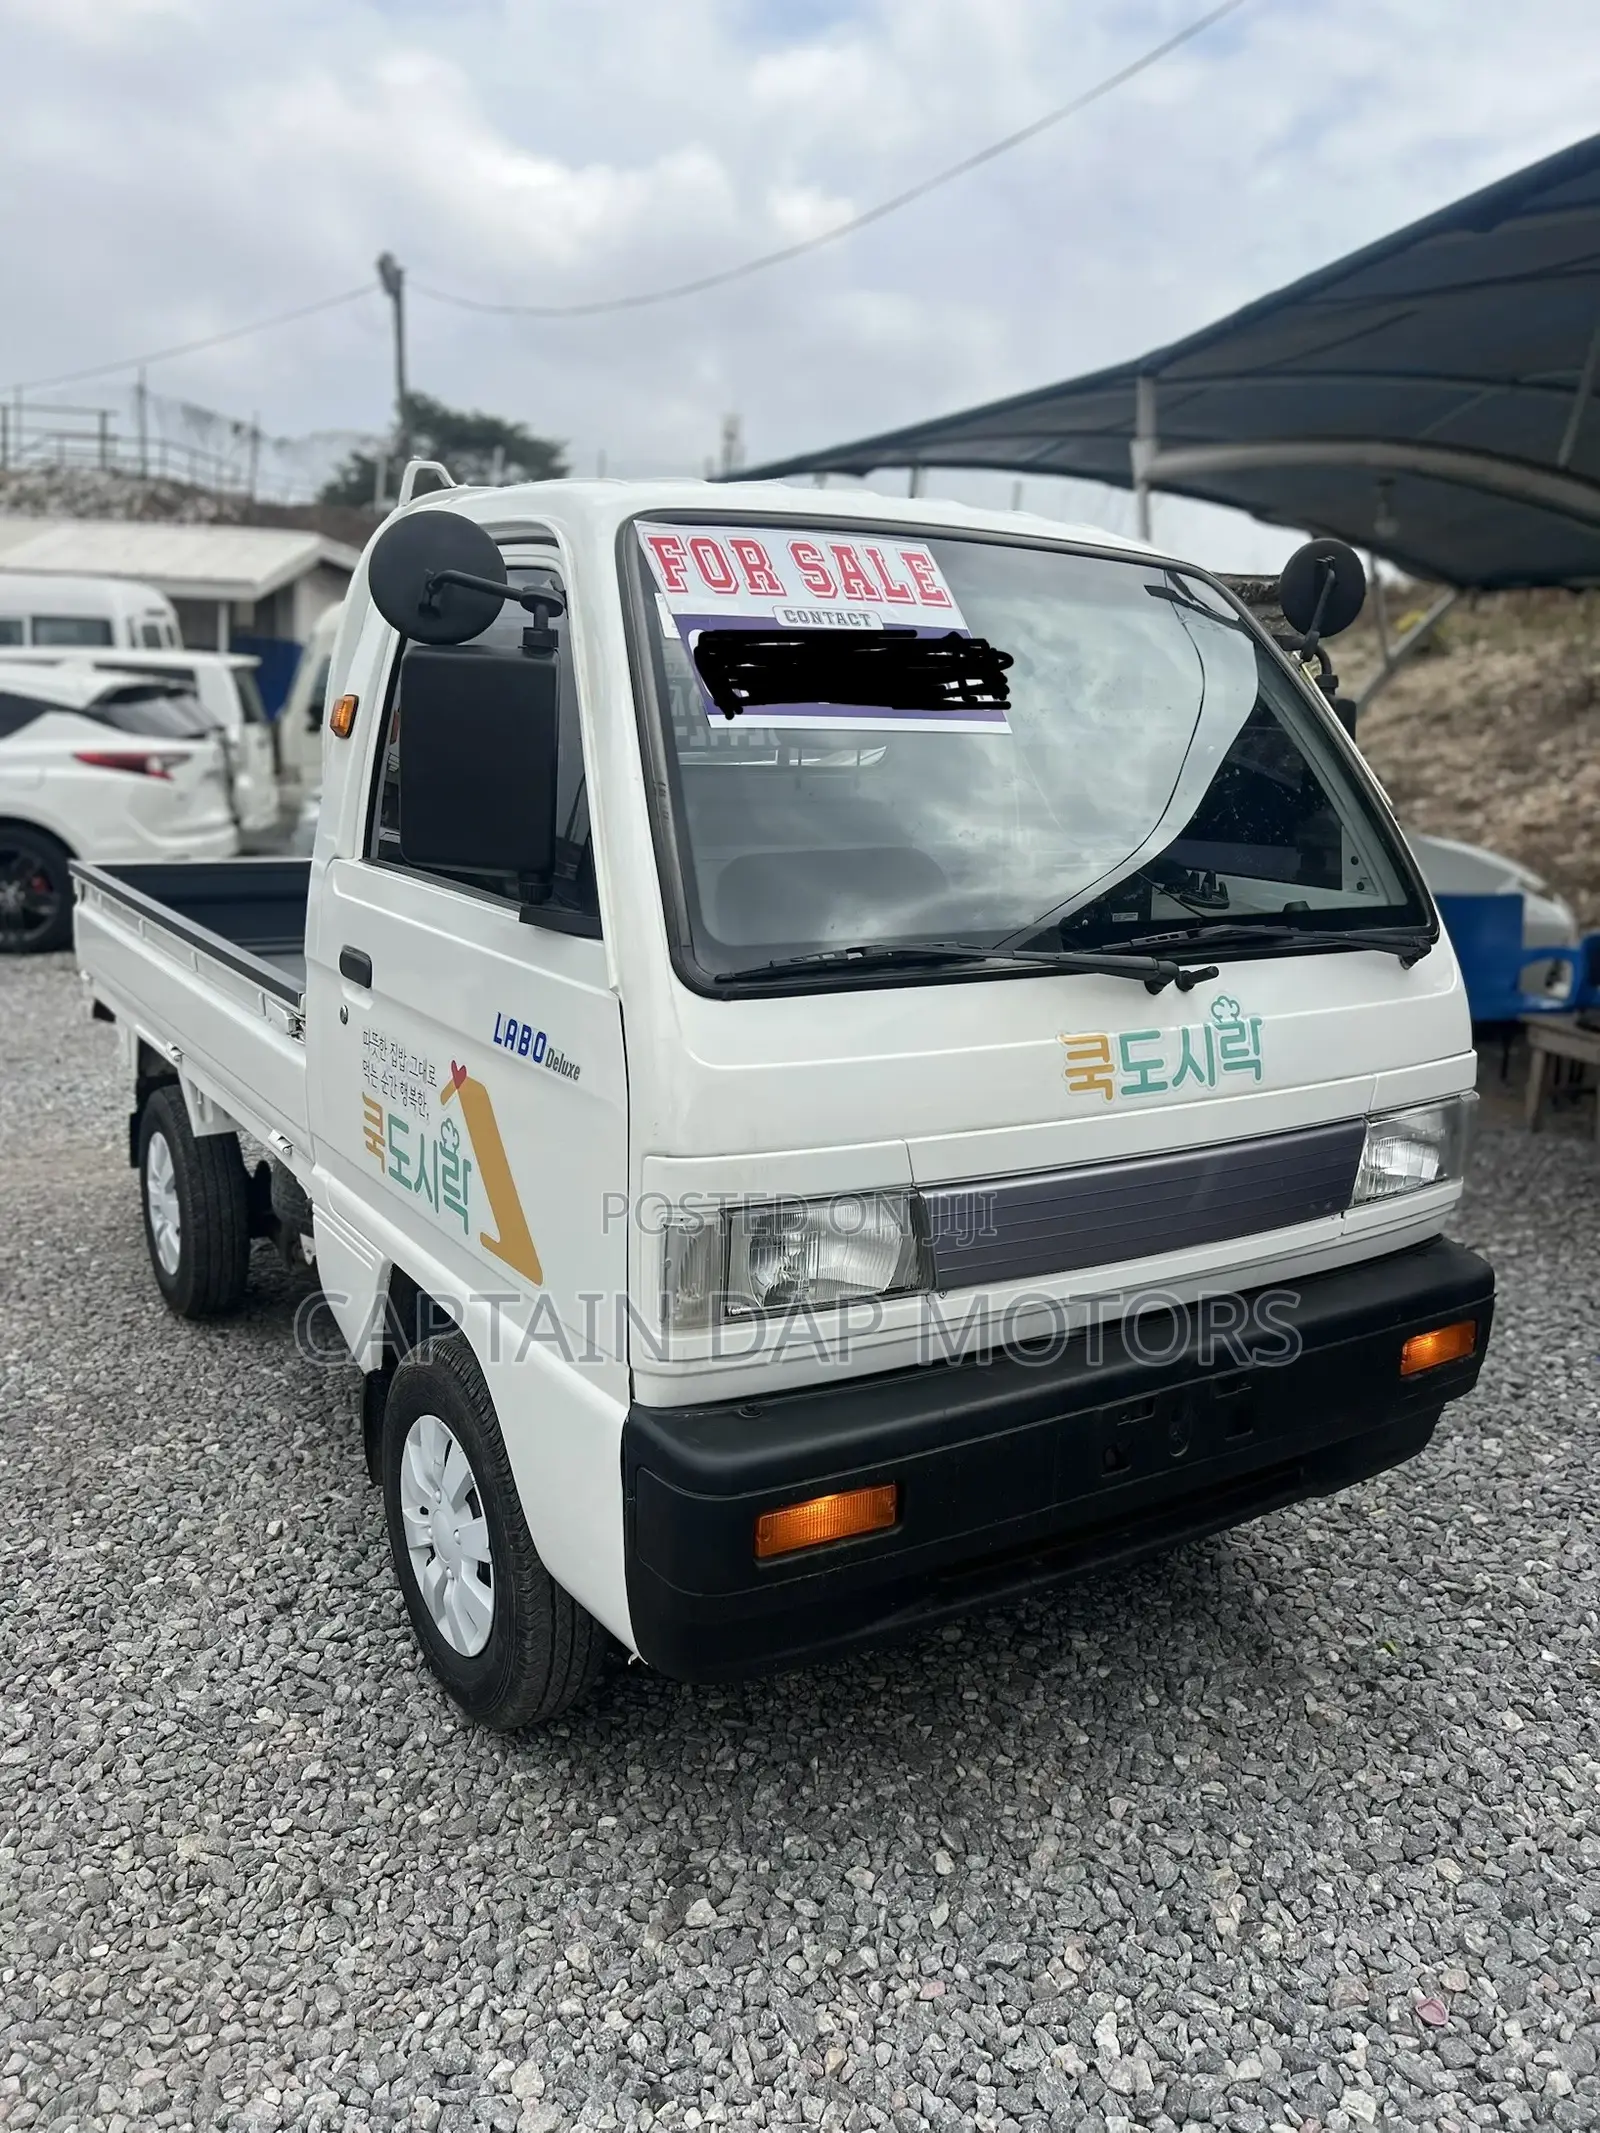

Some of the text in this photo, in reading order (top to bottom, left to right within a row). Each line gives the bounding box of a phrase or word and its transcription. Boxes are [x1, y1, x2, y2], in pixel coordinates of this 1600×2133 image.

[645, 533, 952, 608] FOR SALE
[783, 609, 872, 628] CONTACT
[362, 1059, 379, 1089] 먹는
[381, 1070, 398, 1101] 순간
[363, 1028, 438, 1088] 따뜻한 집밥 그대로
[493, 1011, 581, 1081] LABO Deluxe
[1057, 1018, 1263, 1101] 쿡도시락
[362, 1091, 472, 1236] 쿡도시락
